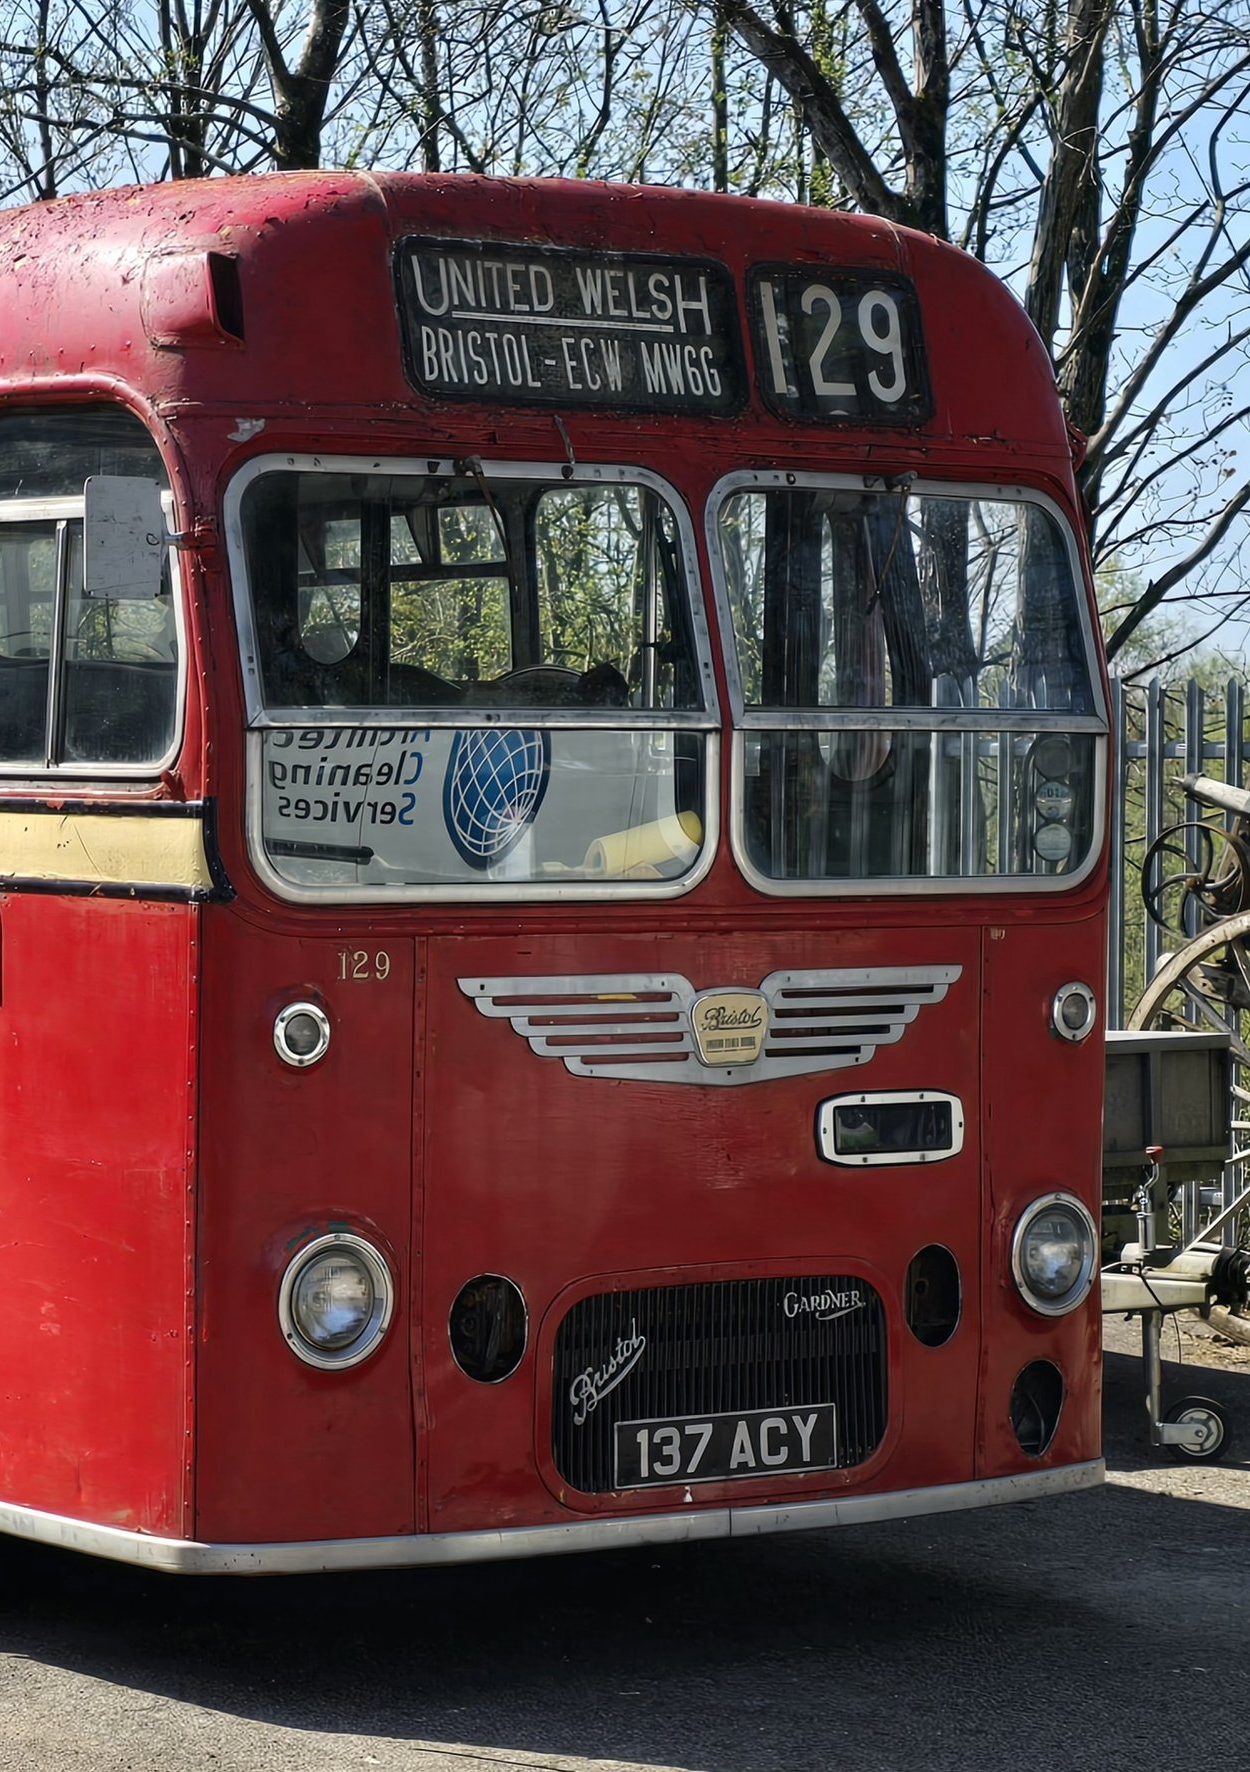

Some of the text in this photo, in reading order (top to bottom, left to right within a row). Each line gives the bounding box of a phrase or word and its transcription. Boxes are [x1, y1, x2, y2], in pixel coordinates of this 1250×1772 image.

[411, 255, 712, 335] UNITED WELSH
[759, 281, 907, 403] 129
[337, 950, 391, 980] 129
[701, 1006, 762, 1030] Bristol
[569, 1317, 646, 1426] Bristol
[636, 1413, 818, 1478] 137 ACY
